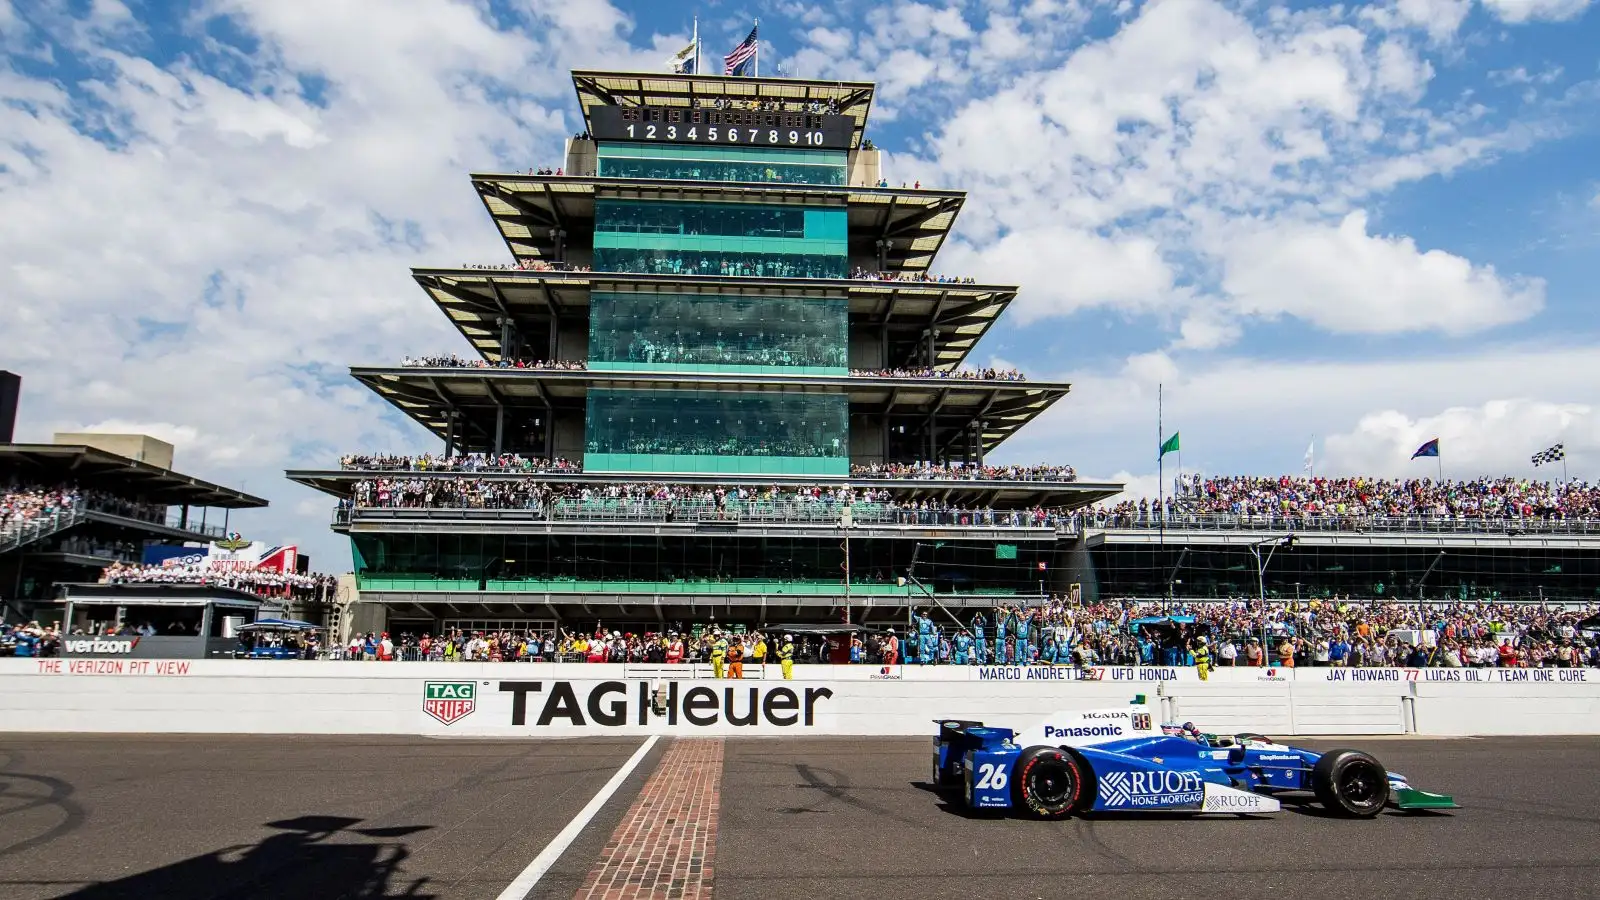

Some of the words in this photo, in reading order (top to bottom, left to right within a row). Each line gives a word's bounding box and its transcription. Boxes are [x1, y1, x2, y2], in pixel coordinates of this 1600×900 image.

[626, 124, 635, 138] 1
[646, 125, 657, 139] 2
[666, 126, 677, 140] 3
[687, 126, 698, 140] 4
[708, 128, 718, 141] 5
[728, 128, 738, 142] 6
[748, 129, 759, 143] 7
[768, 130, 779, 144] 8
[788, 130, 799, 144] 9
[805, 131, 824, 146] 10
[64, 636, 132, 653] verizon
[38, 660, 62, 674] THE
[69, 660, 123, 674] VERIZON
[130, 661, 150, 674] PIT
[156, 662, 190, 674] VIEW
[979, 667, 1021, 680] MARCO
[1112, 668, 1134, 680] UFO
[1140, 668, 1177, 681] HONDA
[1326, 669, 1346, 682] JAY
[1352, 669, 1399, 682] HOWARD
[1404, 670, 1420, 682] 77
[1426, 670, 1460, 682] LUCAS
[1465, 670, 1483, 682] OIL
[1487, 670, 1493, 682] /
[1499, 670, 1528, 682] TEAM
[1533, 670, 1553, 682] ONE
[1559, 670, 1587, 682] CURE
[429, 684, 471, 698] TAG
[427, 700, 472, 721] HEUER
[1082, 712, 1129, 720] HONDA
[1044, 723, 1123, 738] Panasonic
[975, 763, 1008, 790] 26
[1131, 770, 1203, 795] RUOFF
[1132, 794, 1158, 806] HOME
[1220, 795, 1261, 807] RUOFF
